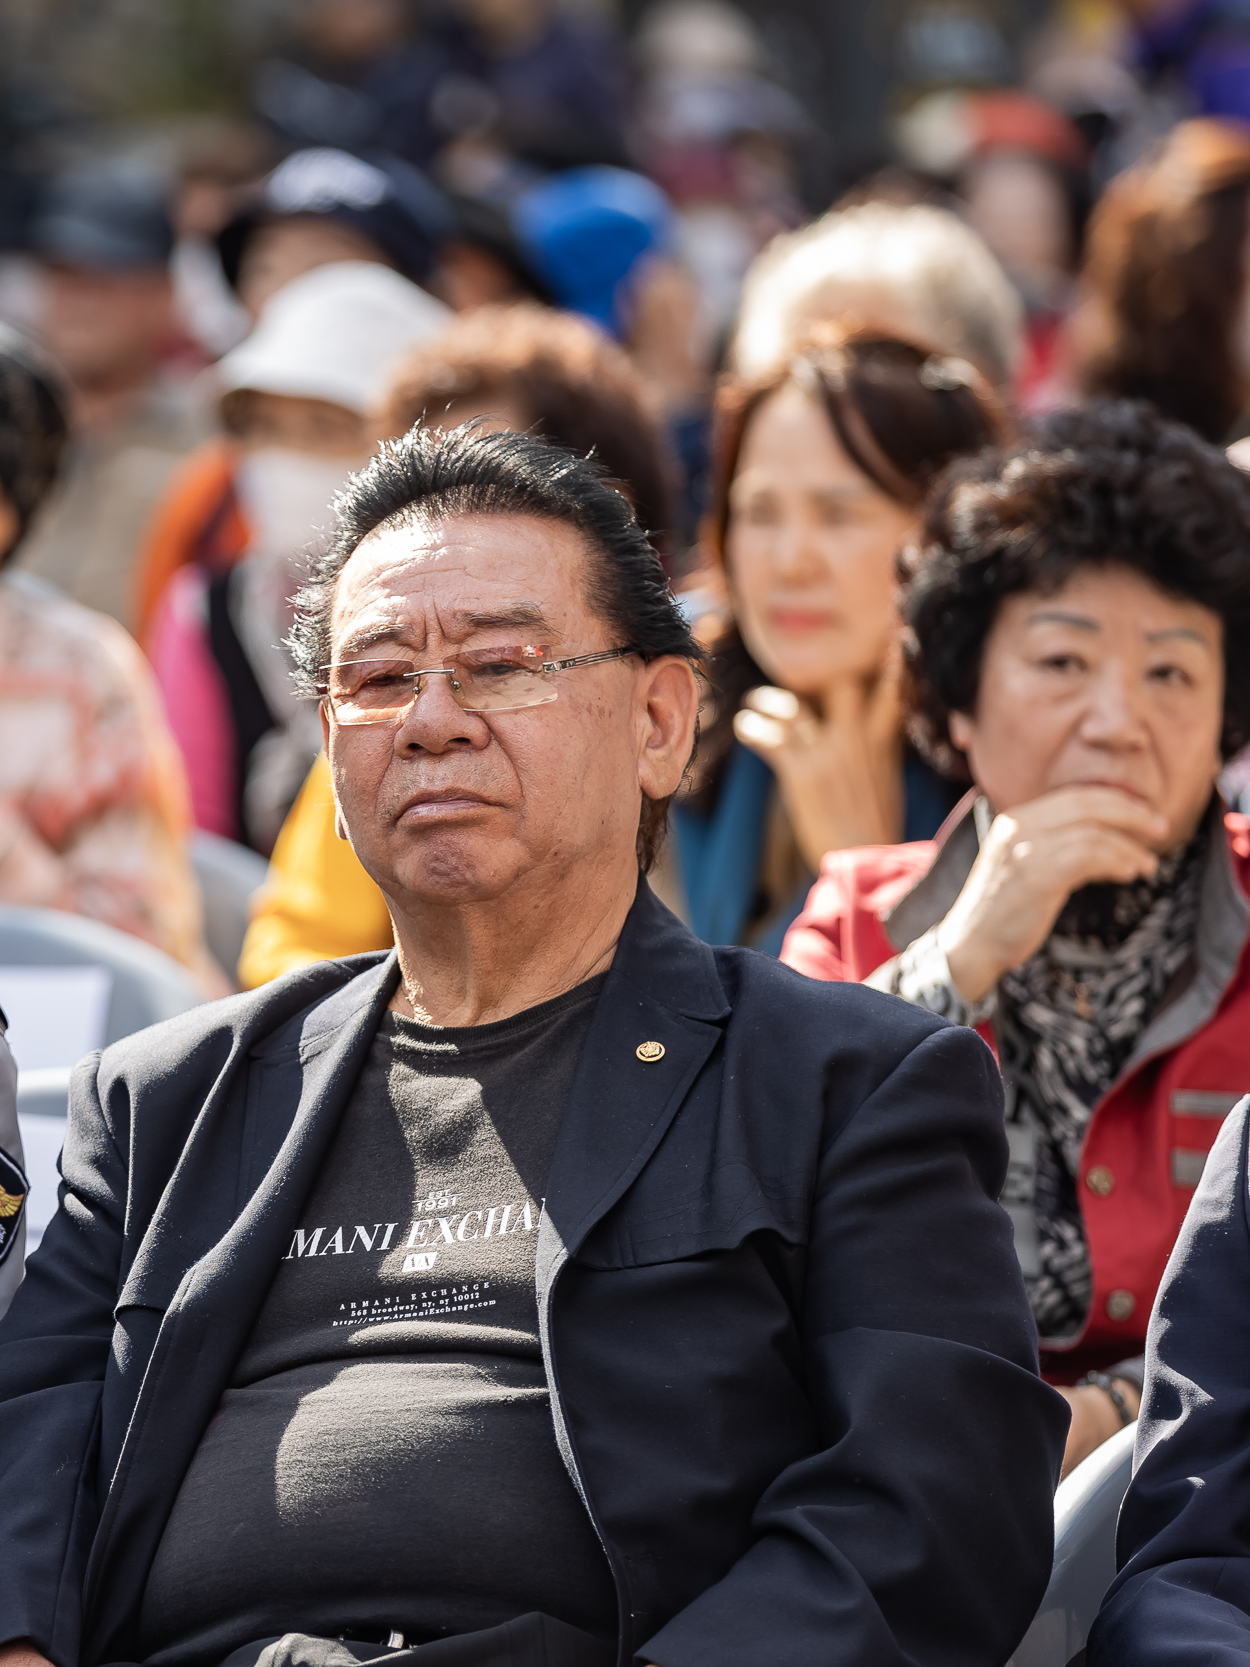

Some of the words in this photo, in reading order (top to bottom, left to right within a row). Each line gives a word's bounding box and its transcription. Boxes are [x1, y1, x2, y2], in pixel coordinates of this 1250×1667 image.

[416, 1197, 457, 1212] 1991
[281, 1223, 398, 1260] MANI
[339, 1296, 400, 1311] ARMANI
[411, 1282, 490, 1301] EXCHANGE
[453, 1292, 480, 1302] 10012
